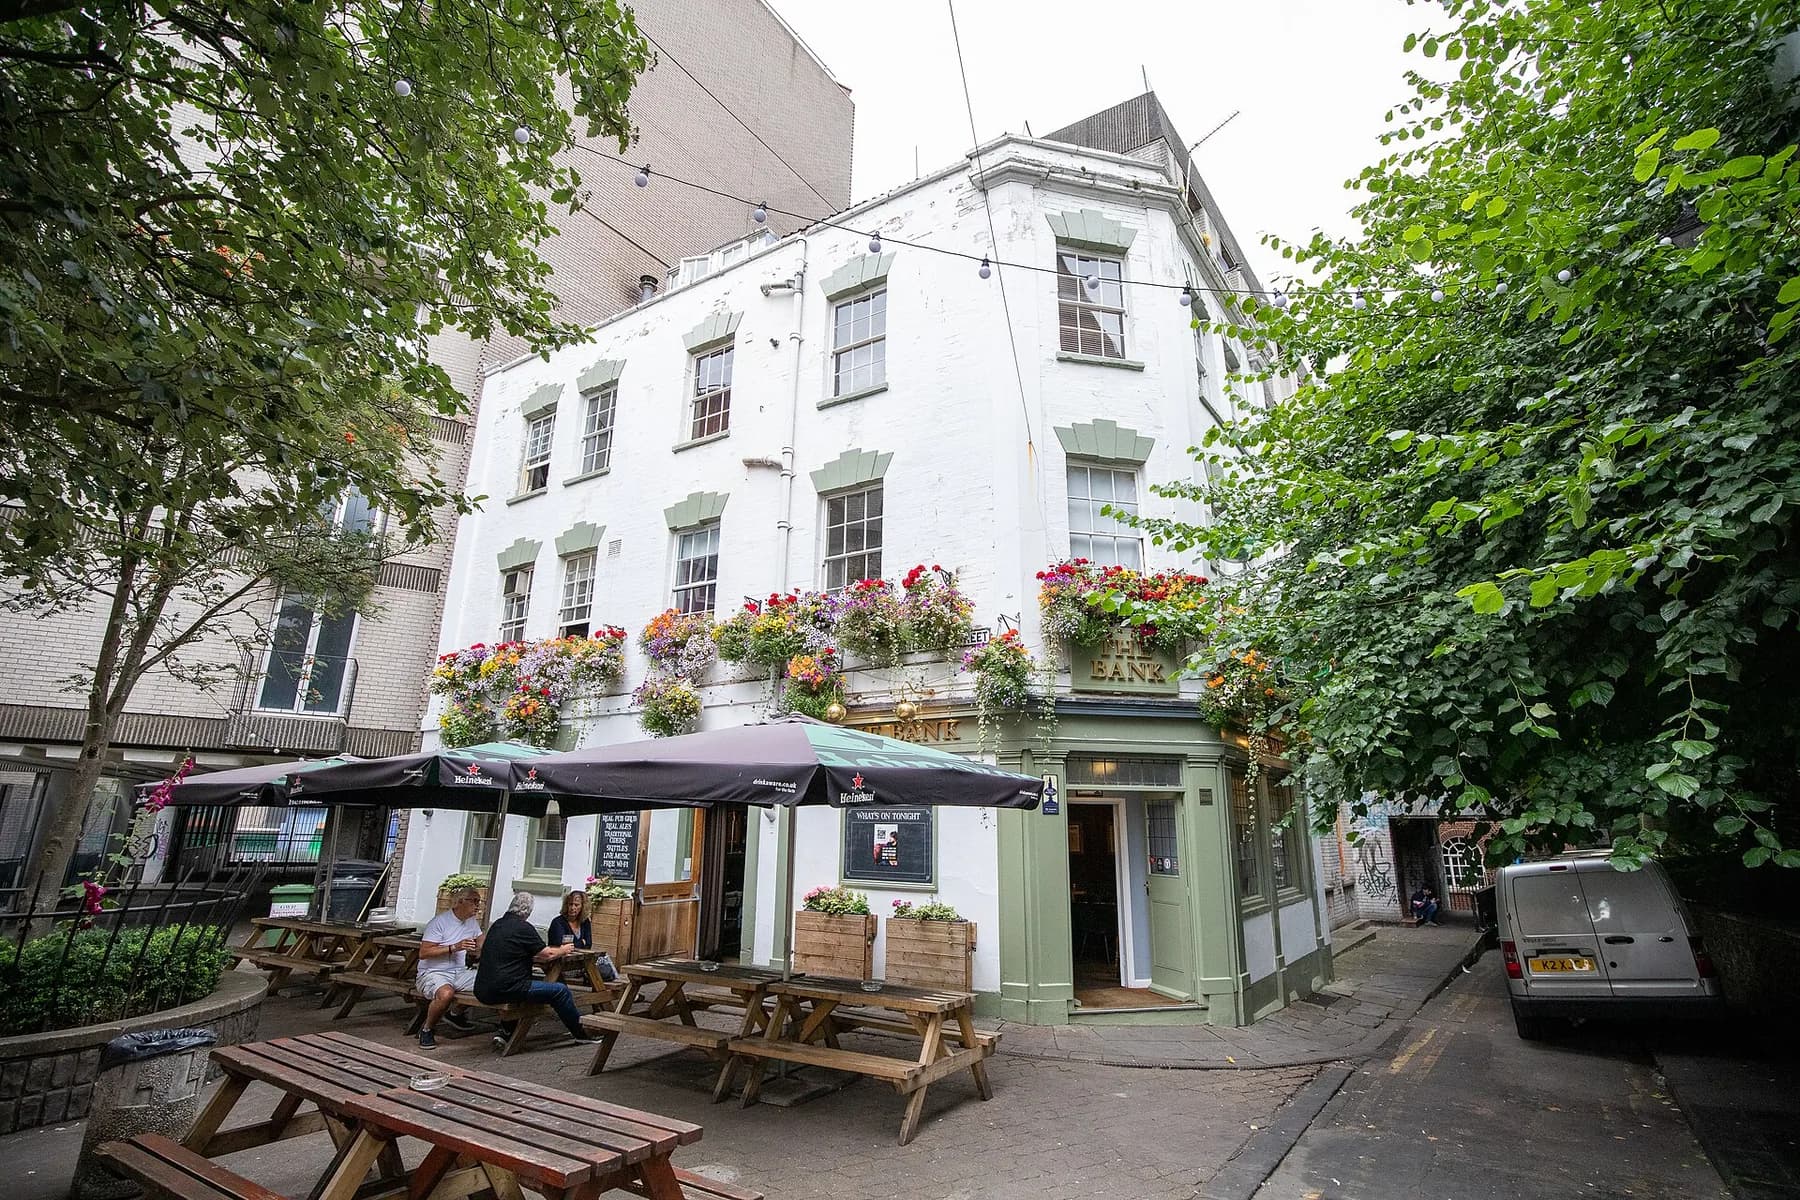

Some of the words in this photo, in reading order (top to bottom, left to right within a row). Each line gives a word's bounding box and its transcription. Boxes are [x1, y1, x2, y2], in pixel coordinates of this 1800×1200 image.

[1091, 660, 1166, 683] BANK
[890, 719, 962, 742] BANK
[454, 775, 493, 786] Heineken
[840, 790, 874, 804] Heineken
[856, 811, 880, 820] WHAT'S
[880, 812, 891, 820] ON
[892, 812, 921, 821] TONIGHT
[1542, 960, 1557, 970] K2
